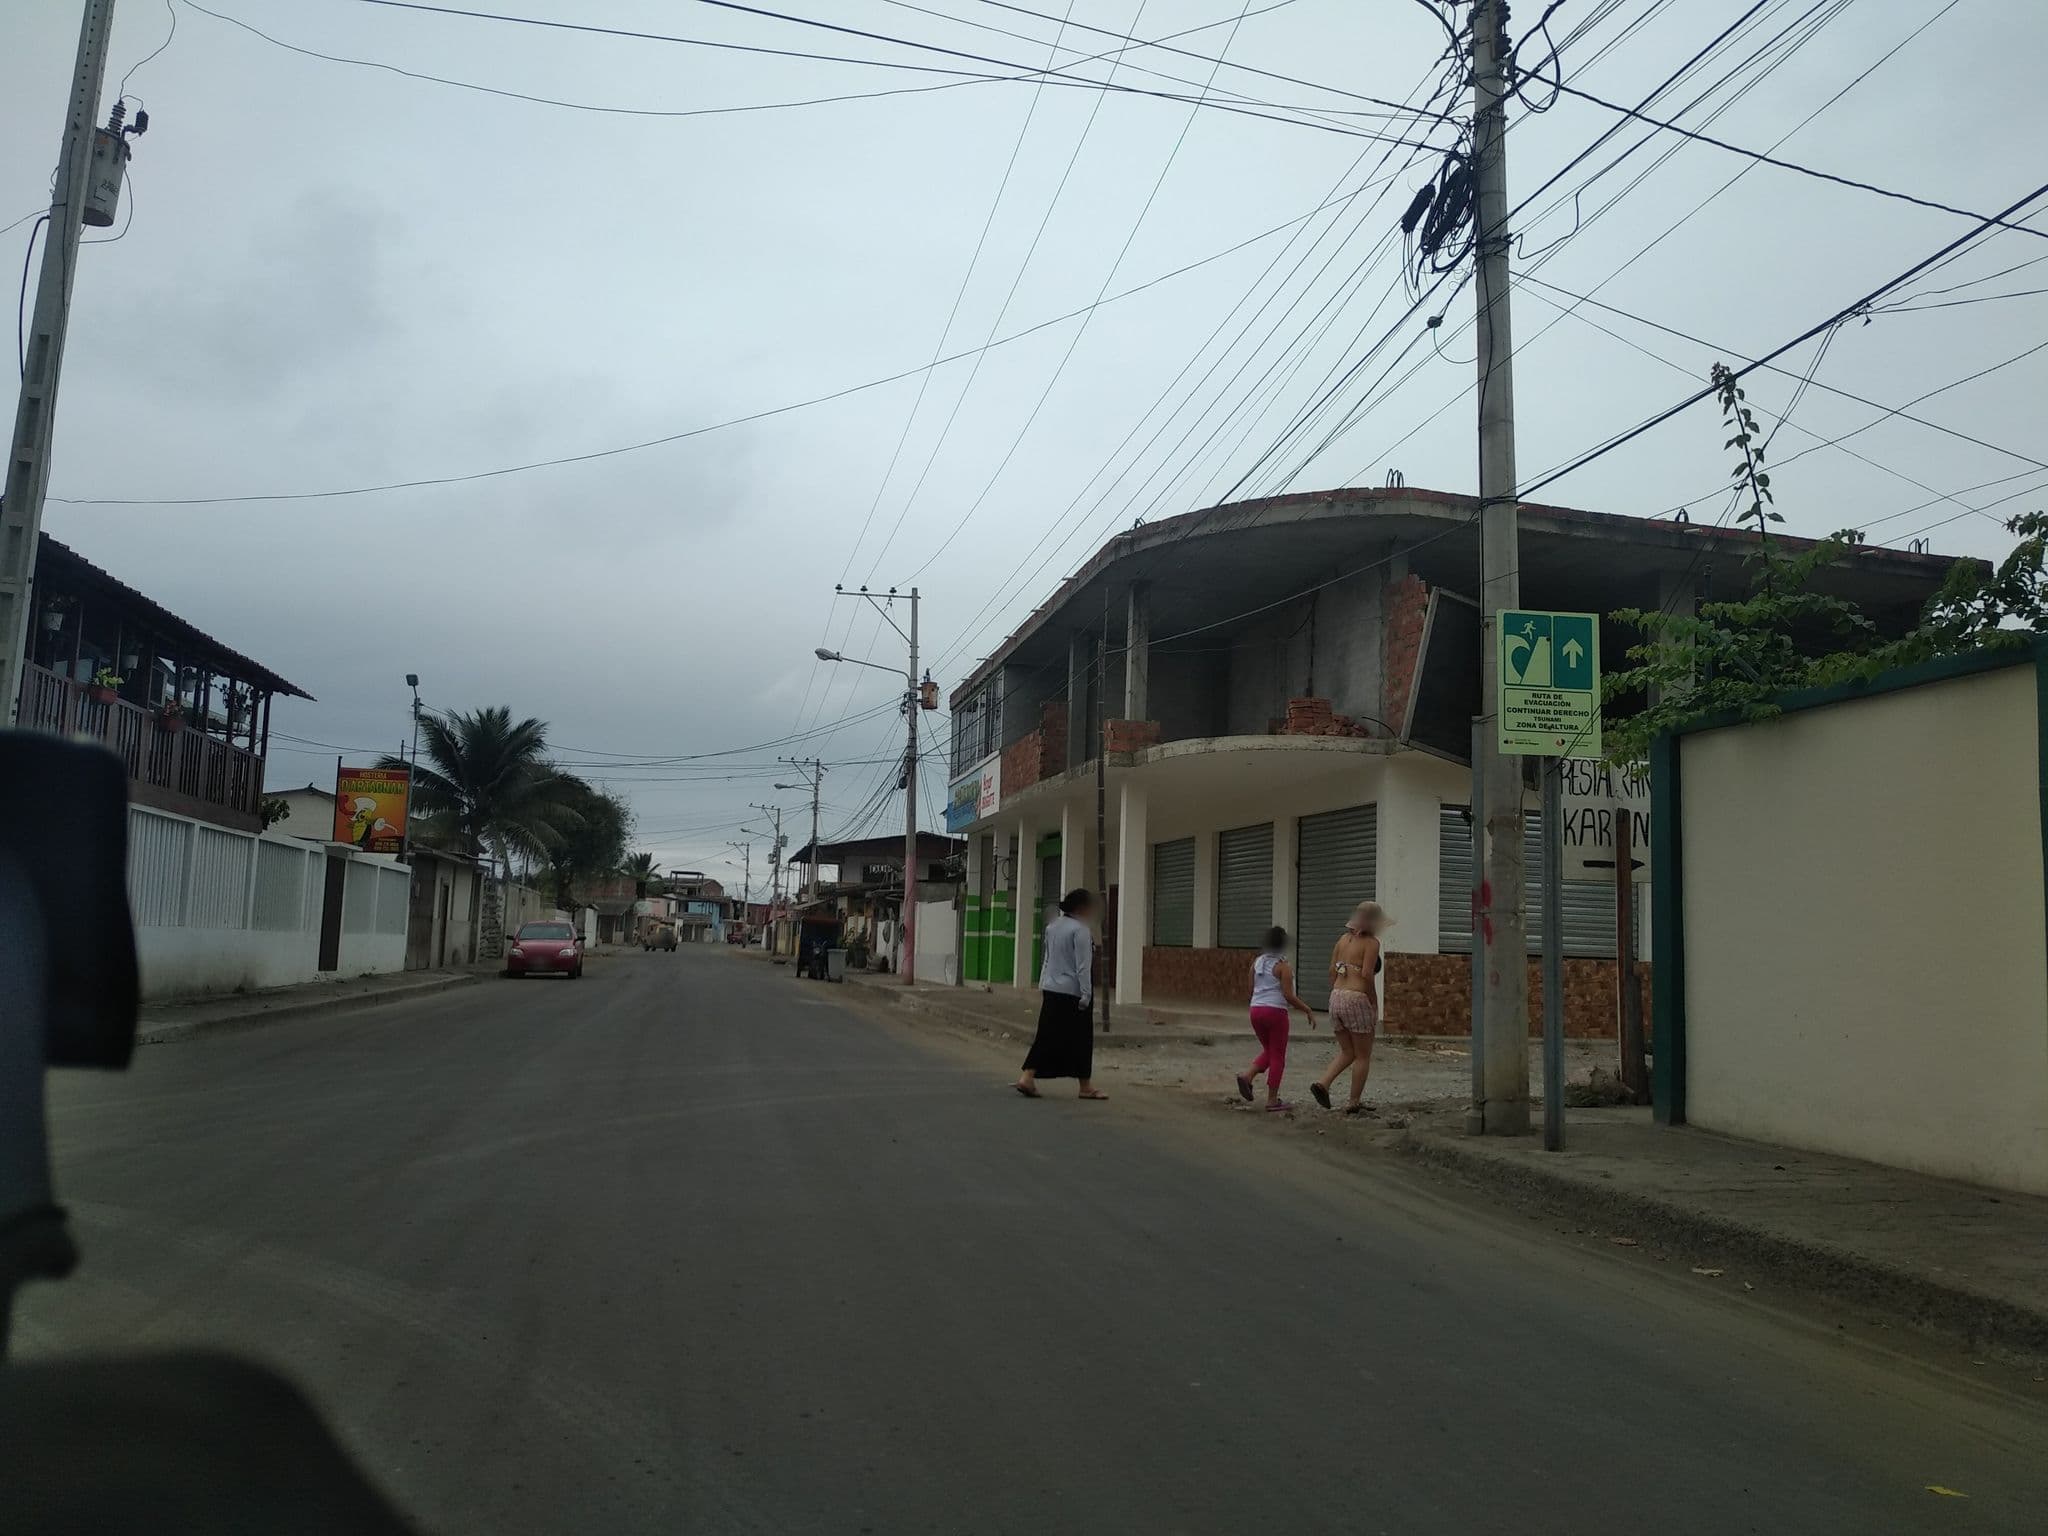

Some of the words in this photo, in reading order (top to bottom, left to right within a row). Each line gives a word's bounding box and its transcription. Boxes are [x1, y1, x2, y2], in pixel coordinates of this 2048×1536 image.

[1532, 692, 1552, 700] RUTA
[1506, 707, 1551, 715] CONTINUAR
[1553, 709, 1590, 717] DERECHO
[1563, 807, 1650, 848] KARN
